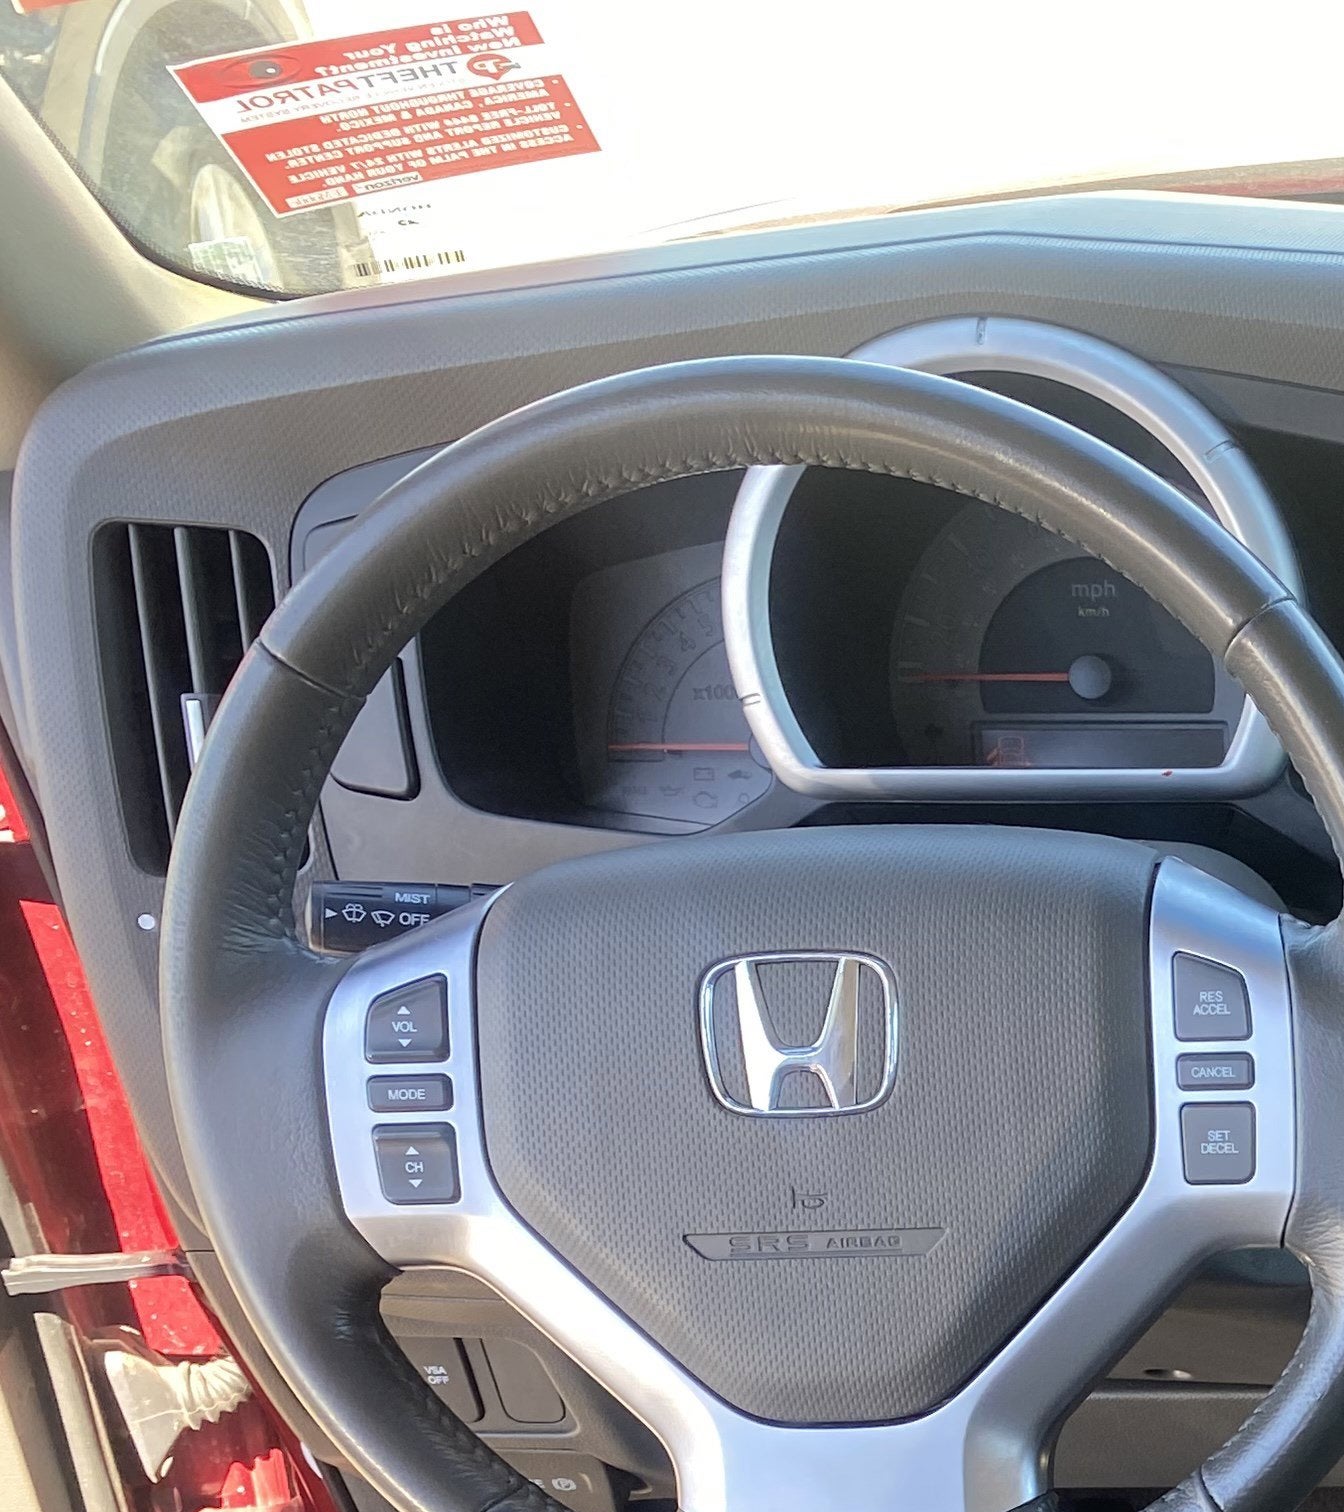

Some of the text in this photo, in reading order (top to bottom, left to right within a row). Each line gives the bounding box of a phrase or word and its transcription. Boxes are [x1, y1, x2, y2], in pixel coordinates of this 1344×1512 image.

[1071, 580, 1116, 601] mph
[395, 892, 430, 904] MIST
[399, 912, 430, 925] OFF
[1199, 991, 1223, 1002] RES
[1193, 1004, 1231, 1015] ACCEL
[392, 1021, 417, 1033] VOL
[1191, 1067, 1236, 1078] CANCEL
[388, 1089, 426, 1100] MODE
[1208, 1130, 1231, 1142] SET
[1200, 1142, 1239, 1154] DECEL
[405, 1162, 424, 1173] CH
[728, 1234, 900, 1252] SRS AIRBAG
[423, 1366, 447, 1375] VSA
[427, 1375, 450, 1384] OFF
